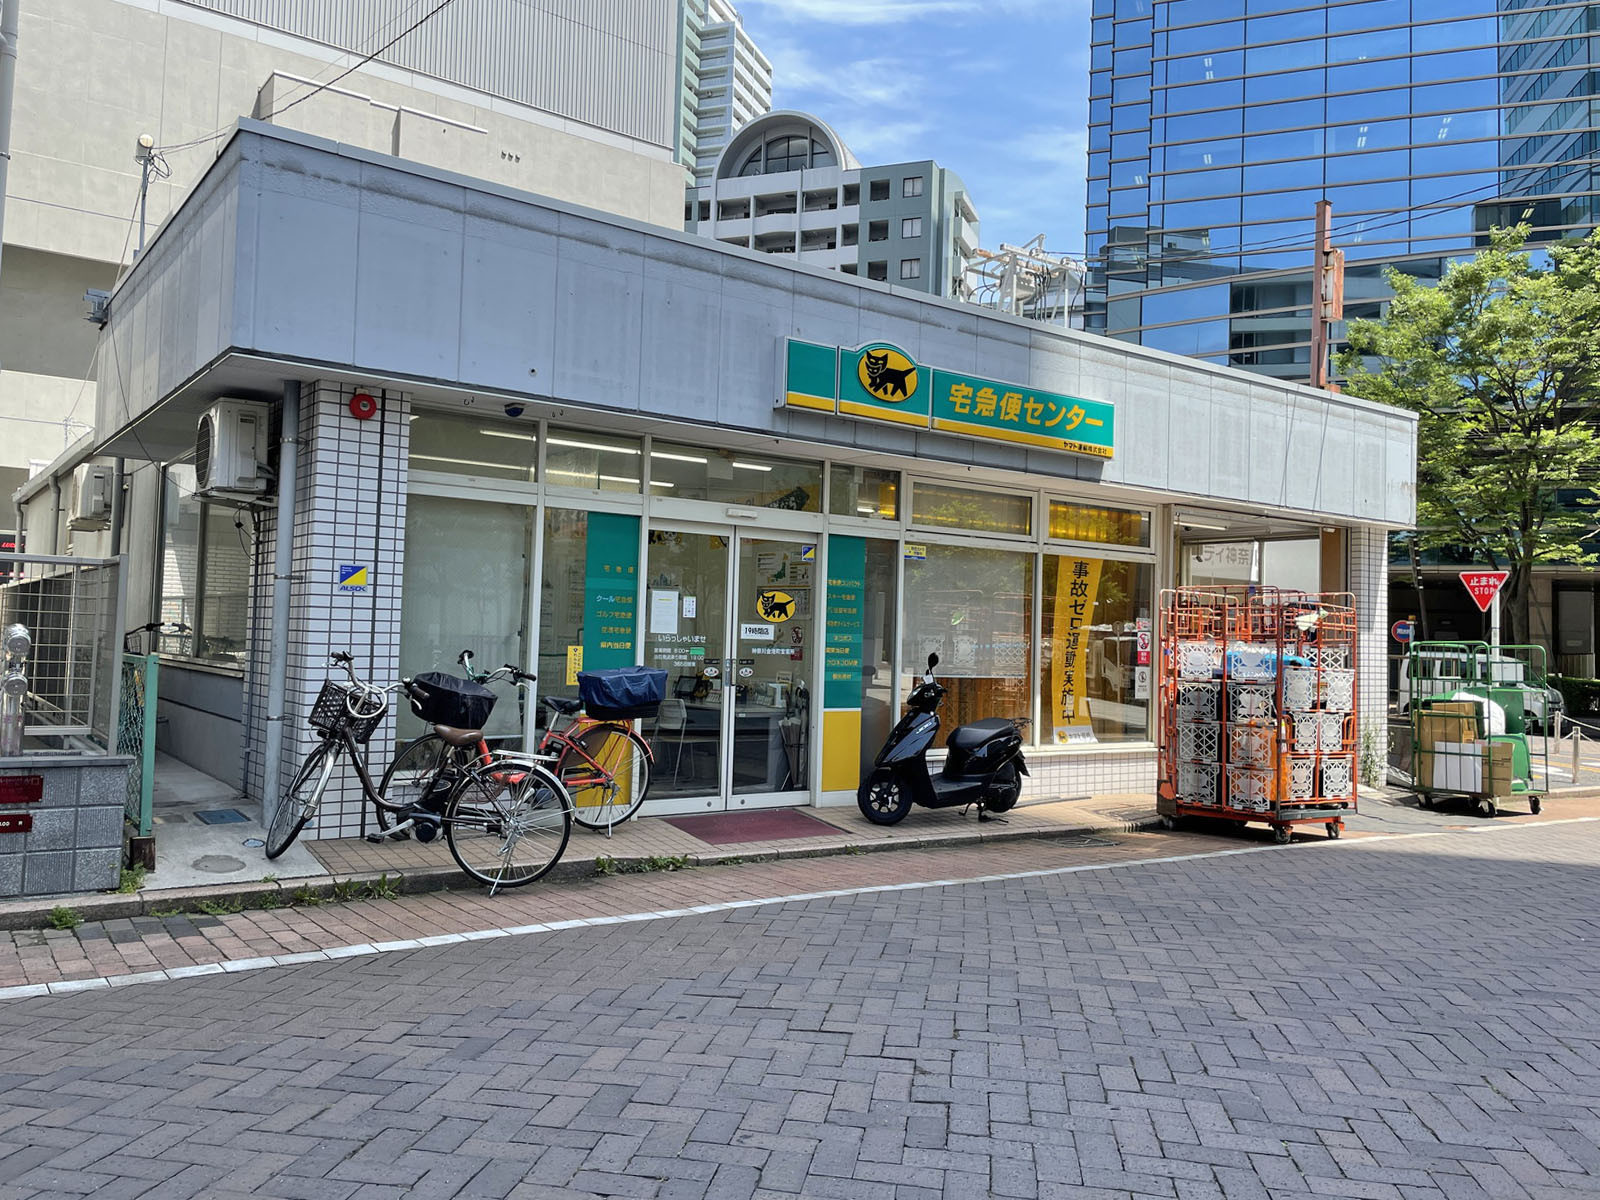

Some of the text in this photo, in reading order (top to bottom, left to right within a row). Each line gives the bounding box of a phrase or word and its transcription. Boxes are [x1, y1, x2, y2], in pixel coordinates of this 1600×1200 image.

[949, 382, 1104, 430] 宅急便センター
[1470, 576, 1500, 586] 止まれ
[1474, 587, 1496, 595] STOP
[657, 634, 706, 643] いらっしゃいませ
[1061, 560, 1090, 725] 事故ゼロ運動実施中
